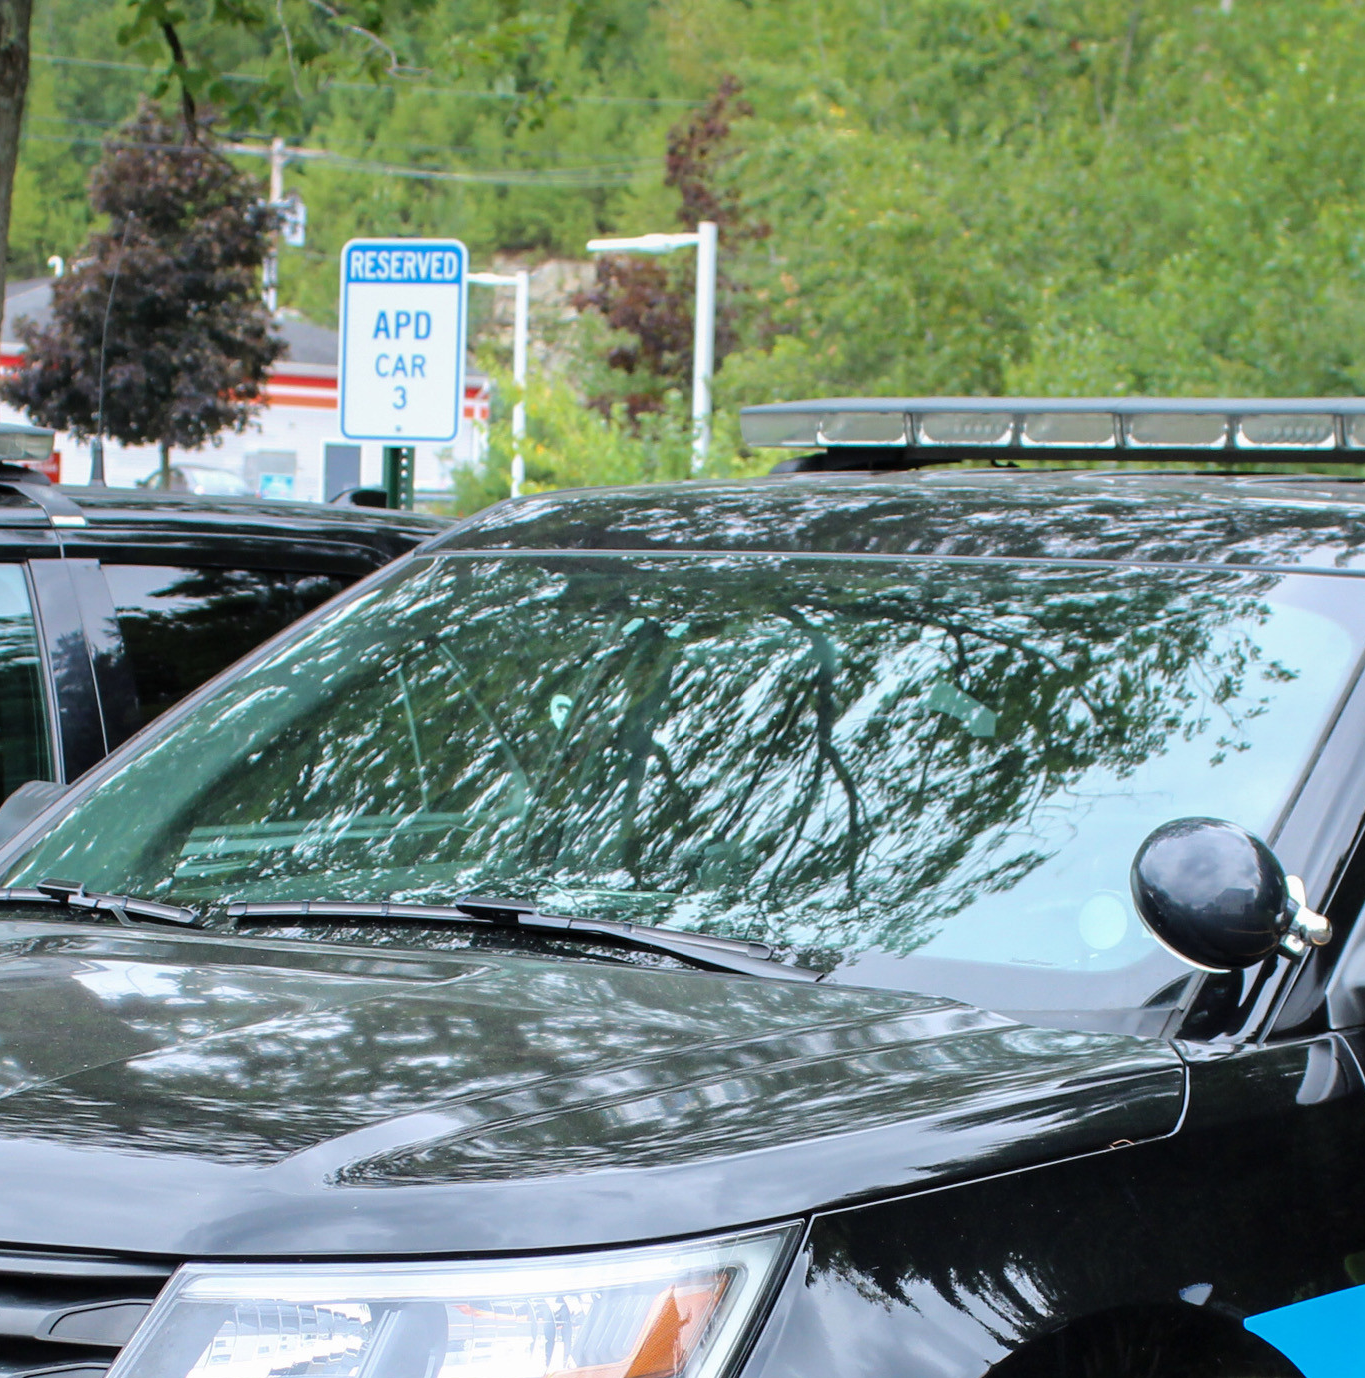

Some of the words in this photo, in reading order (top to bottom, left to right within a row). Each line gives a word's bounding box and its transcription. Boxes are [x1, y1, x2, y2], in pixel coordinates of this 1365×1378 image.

[350, 251, 459, 281] RESERVED
[372, 310, 432, 340] APD
[375, 353, 426, 378] CAR
[392, 385, 408, 410] 3
